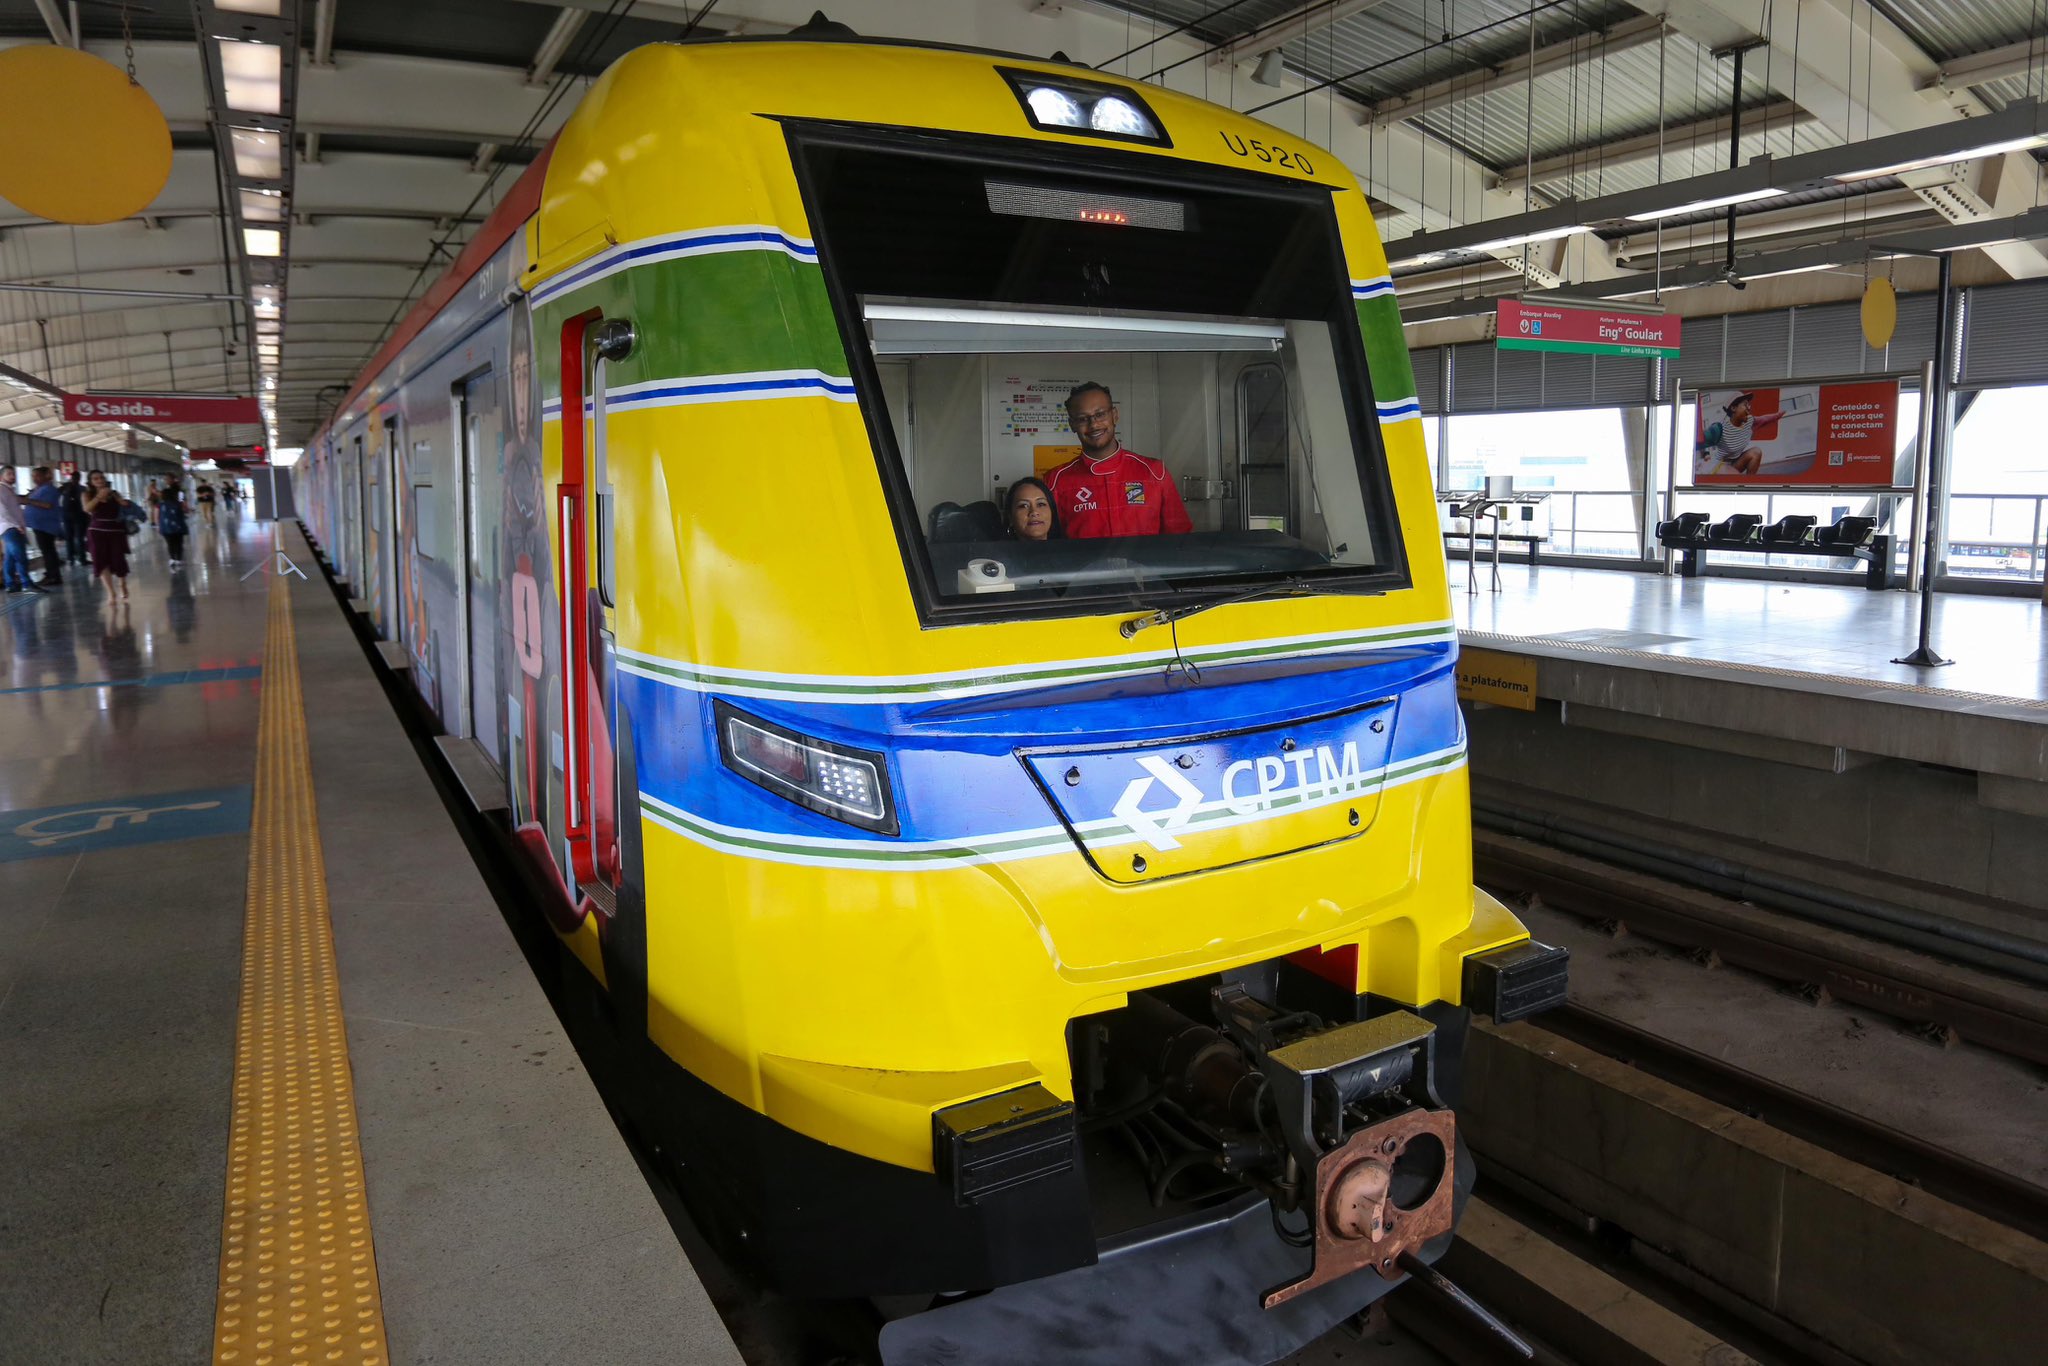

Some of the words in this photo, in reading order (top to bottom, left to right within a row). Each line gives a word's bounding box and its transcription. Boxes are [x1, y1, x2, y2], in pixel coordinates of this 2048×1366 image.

[1219, 130, 1314, 175] U520
[1625, 327, 1663, 341] Goulart
[96, 402, 155, 416] Saída
[1831, 403, 1873, 411] Conteúdo
[1831, 413, 1866, 421] serviços
[1073, 502, 1097, 512] CPTM
[1471, 676, 1529, 692] plataforma
[1221, 741, 1361, 816] CPTM
